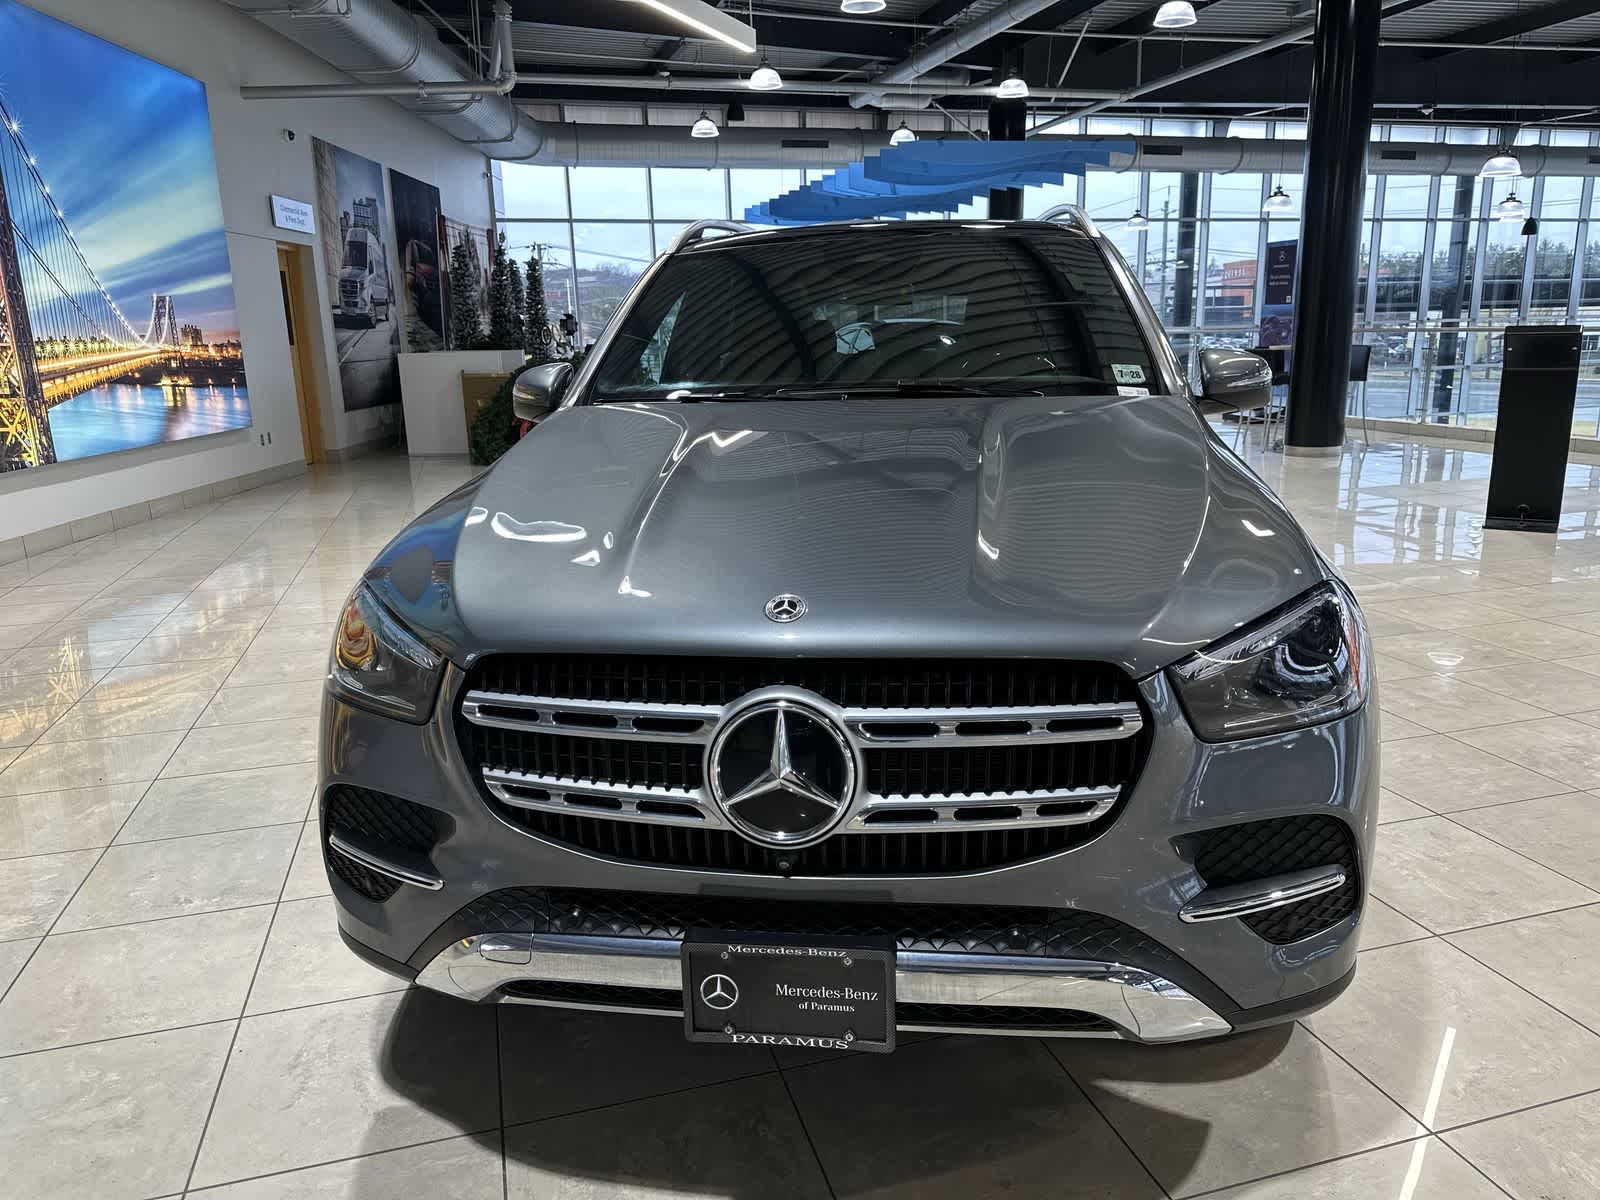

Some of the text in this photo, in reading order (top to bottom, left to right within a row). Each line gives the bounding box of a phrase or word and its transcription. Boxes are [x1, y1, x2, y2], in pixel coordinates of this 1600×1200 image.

[1117, 369, 1124, 378] 7
[727, 944, 848, 958] Mercedes-Benz
[775, 983, 878, 1001] Mercedes-Benz
[798, 1001, 855, 1013] of Paramus
[731, 1034, 849, 1050] PARAMUS
